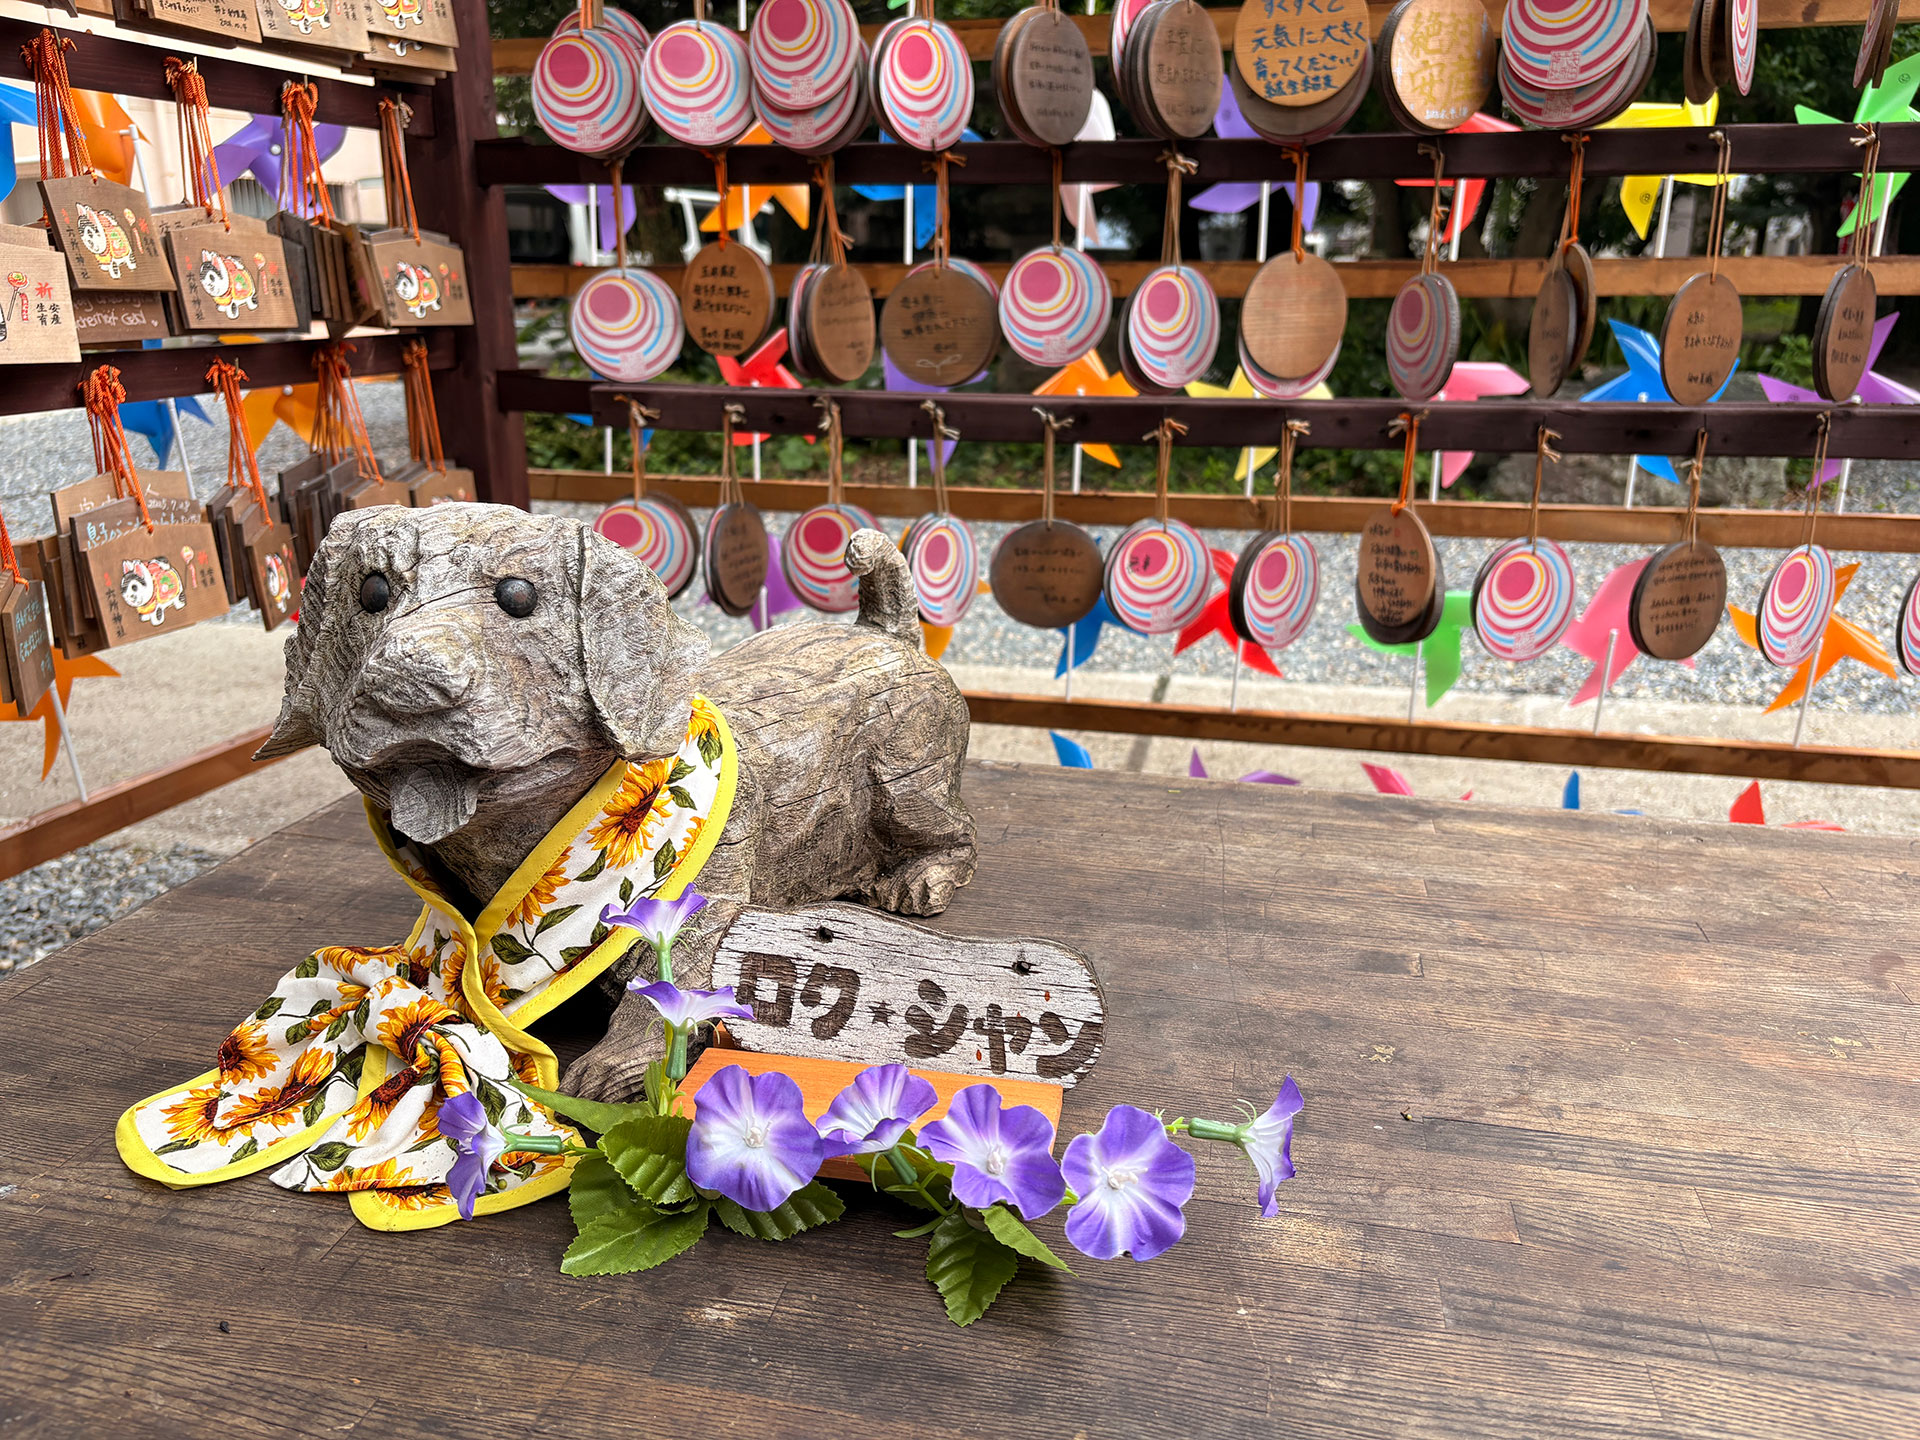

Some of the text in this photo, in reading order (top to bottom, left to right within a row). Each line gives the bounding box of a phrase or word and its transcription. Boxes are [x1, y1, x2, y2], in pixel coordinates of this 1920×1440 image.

[1251, 20, 1367, 53] 元気に大きく
[35, 282, 53, 300] 祈
[49, 303, 62, 325] 安産
